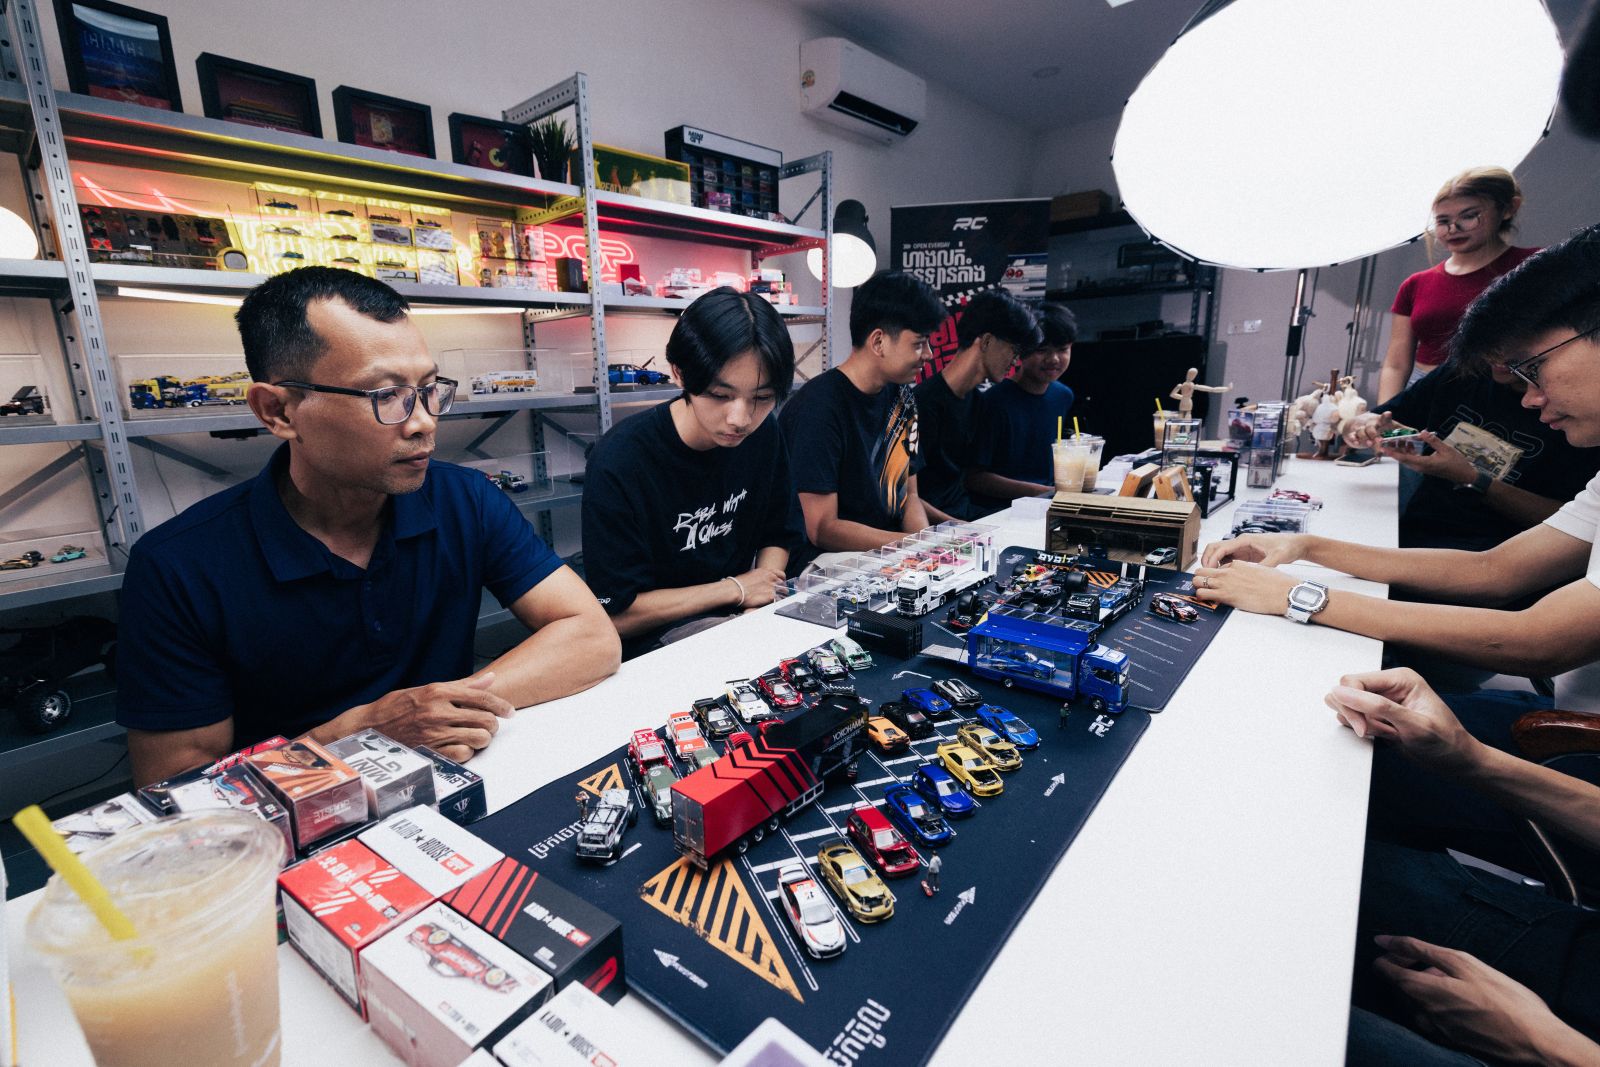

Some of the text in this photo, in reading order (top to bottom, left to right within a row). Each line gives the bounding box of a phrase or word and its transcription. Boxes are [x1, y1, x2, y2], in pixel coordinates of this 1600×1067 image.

[953, 216, 988, 231] RC
[832, 717, 865, 741] YOKOHAMA
[350, 757, 393, 784] MINI
[366, 755, 402, 773] GT
[388, 819, 455, 862] KAIDO HOUSE
